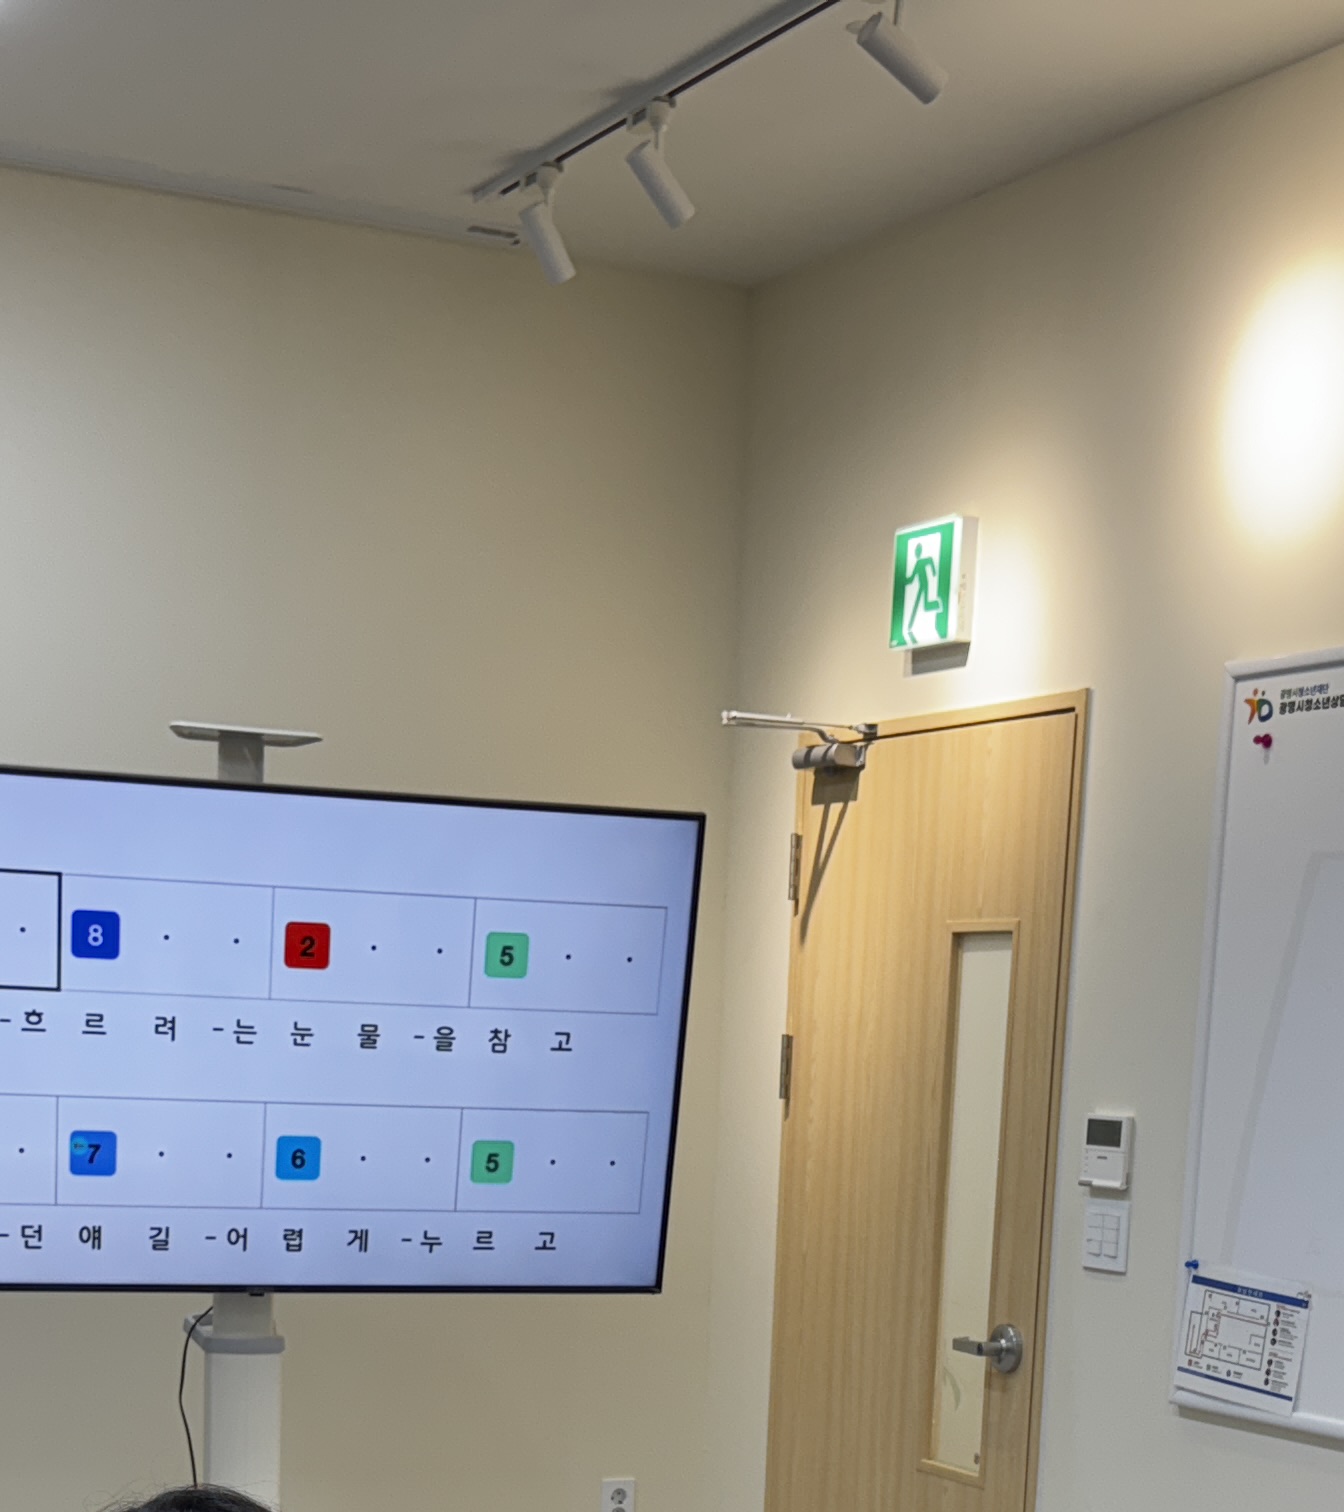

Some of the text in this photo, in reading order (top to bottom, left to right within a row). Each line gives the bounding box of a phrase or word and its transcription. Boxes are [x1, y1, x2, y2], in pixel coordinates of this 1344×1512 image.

[87, 924, 104, 946] 8
[300, 935, 317, 957] 2
[498, 945, 515, 967] 5
[81, 1013, 107, 1036] 르
[154, 1015, 176, 1042] 려
[290, 1021, 314, 1047] 눈
[357, 1023, 381, 1050] 물
[488, 1027, 512, 1054] 참
[549, 1031, 573, 1052] 고
[87, 1143, 102, 1165] 7
[290, 1148, 306, 1170] 6
[485, 1152, 501, 1174] 5
[78, 1225, 102, 1251] 얘
[148, 1226, 170, 1252] 길
[282, 1227, 304, 1253] 렵
[346, 1228, 369, 1254] 게
[472, 1230, 496, 1251] 르
[533, 1231, 557, 1251] 고
